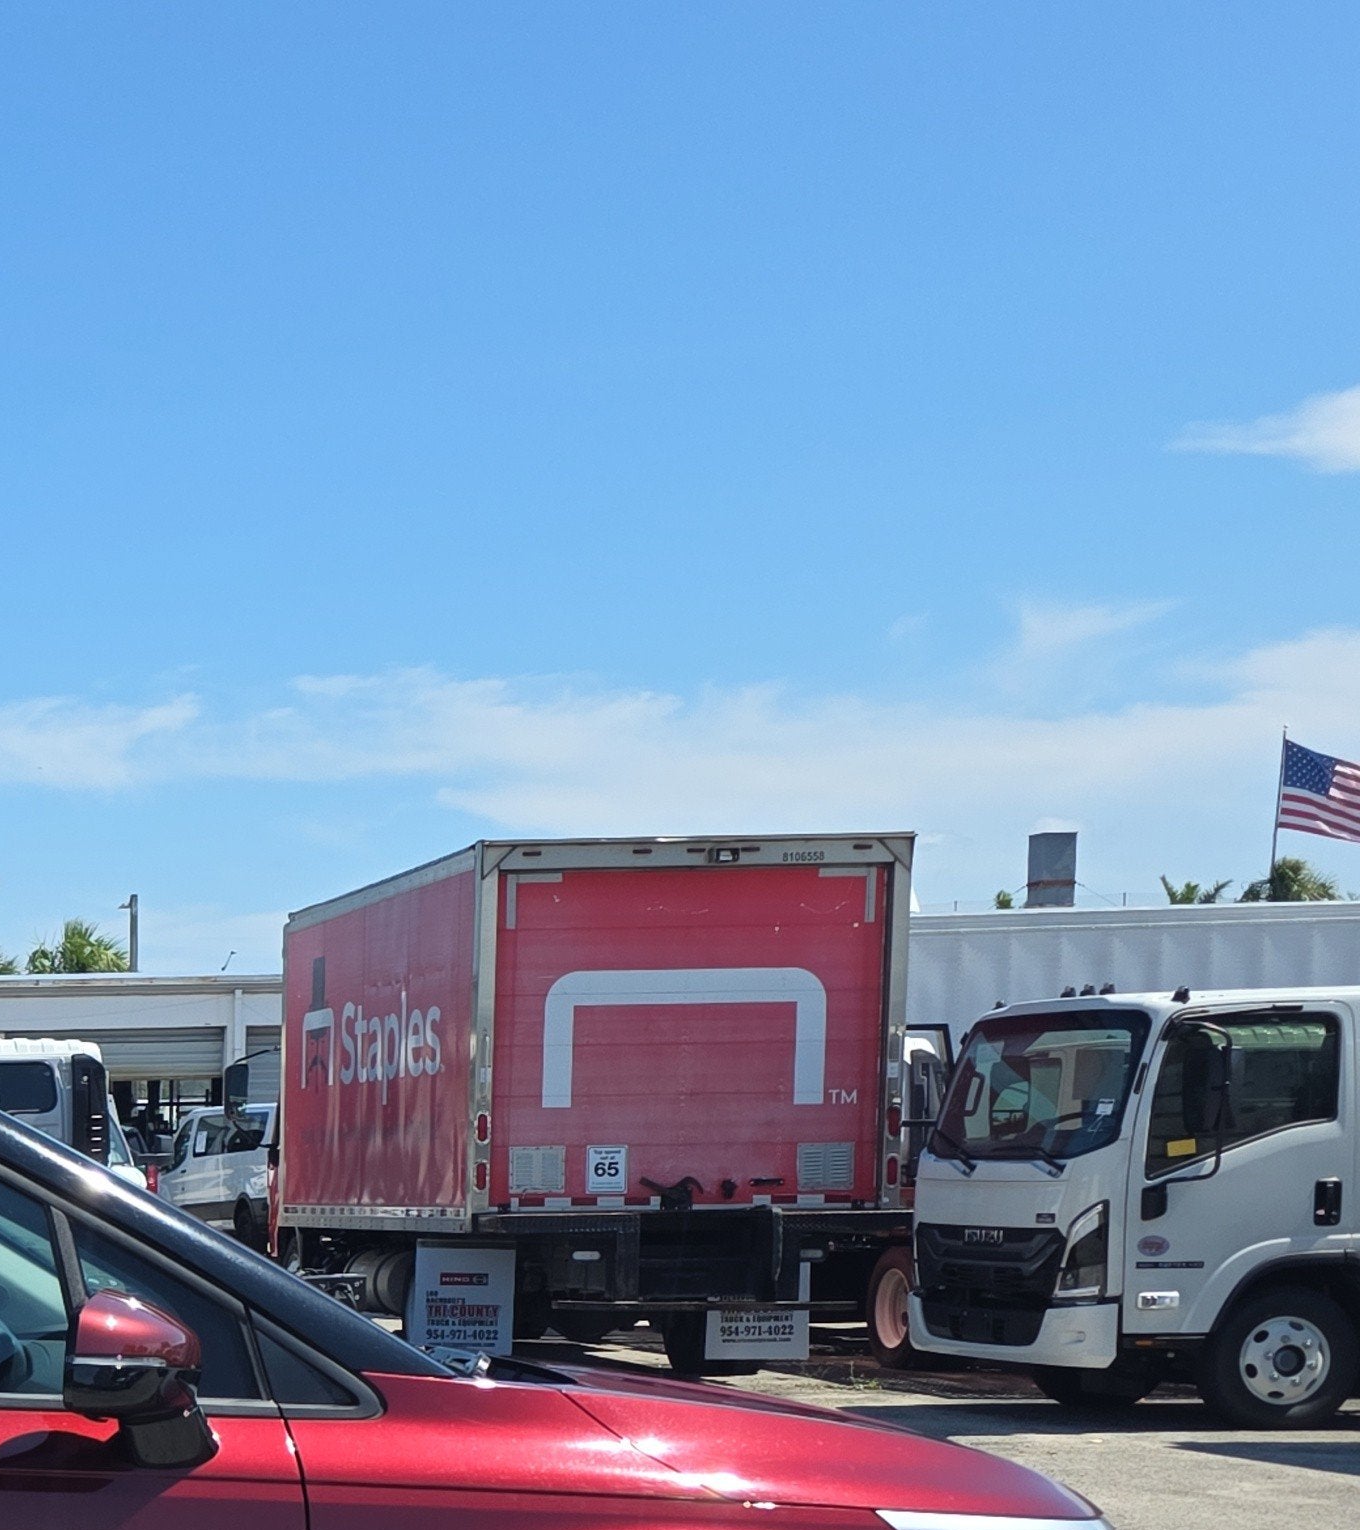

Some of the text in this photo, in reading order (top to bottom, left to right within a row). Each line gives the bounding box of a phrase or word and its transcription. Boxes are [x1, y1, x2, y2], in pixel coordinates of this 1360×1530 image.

[340, 990, 442, 1105] Staples
[827, 1089, 858, 1104] TM
[594, 1161, 620, 1178] 65
[425, 1329, 499, 1341] 954-971-4022
[720, 1325, 795, 1337] 954-971-4022
